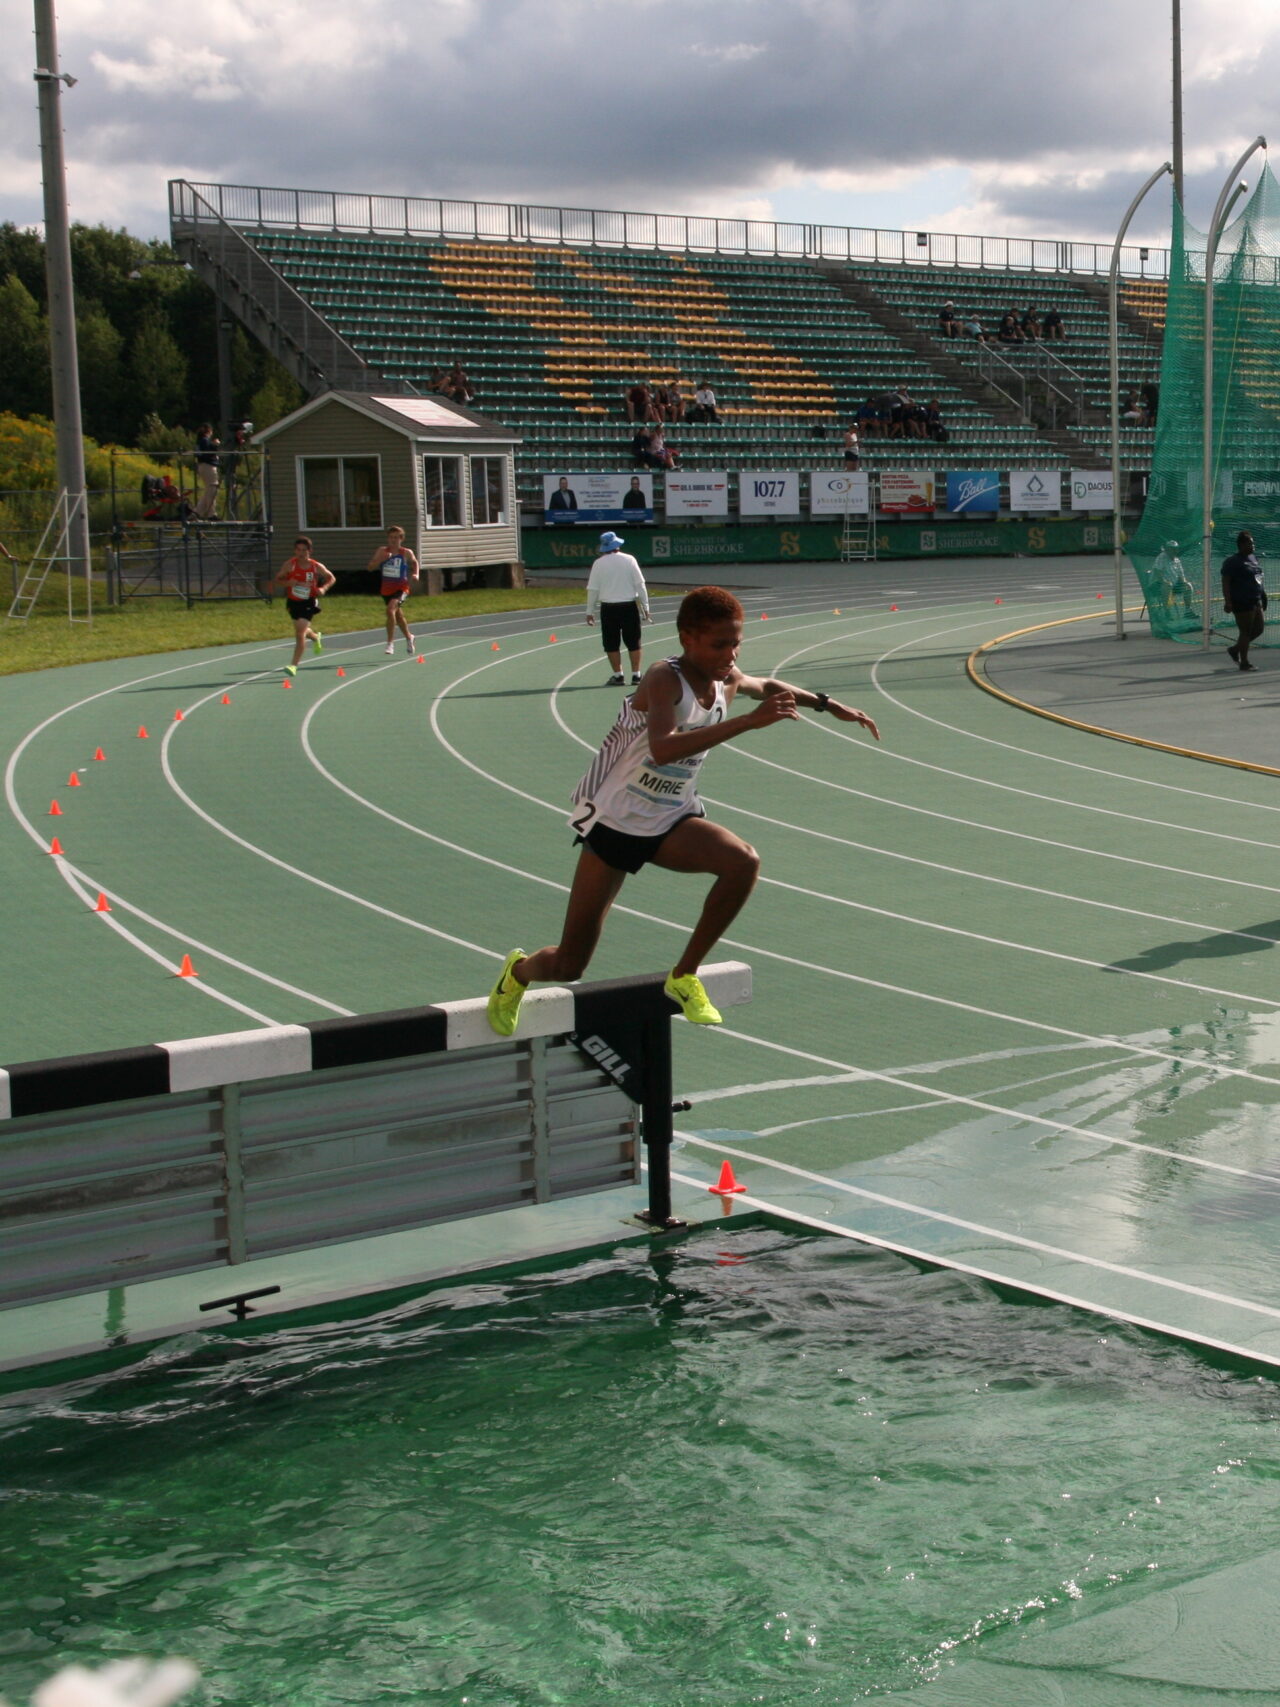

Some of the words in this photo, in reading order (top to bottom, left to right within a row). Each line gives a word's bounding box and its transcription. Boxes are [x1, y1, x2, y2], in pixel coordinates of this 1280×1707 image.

[754, 481, 786, 497] 107.7
[959, 477, 988, 501] Ball
[1088, 482, 1114, 491] DAOUS
[550, 541, 585, 557] VERT
[674, 543, 744, 556] SHERBROOKE
[638, 772, 686, 796] MIRIE
[571, 802, 597, 833] 2
[582, 1035, 631, 1079] GILL
